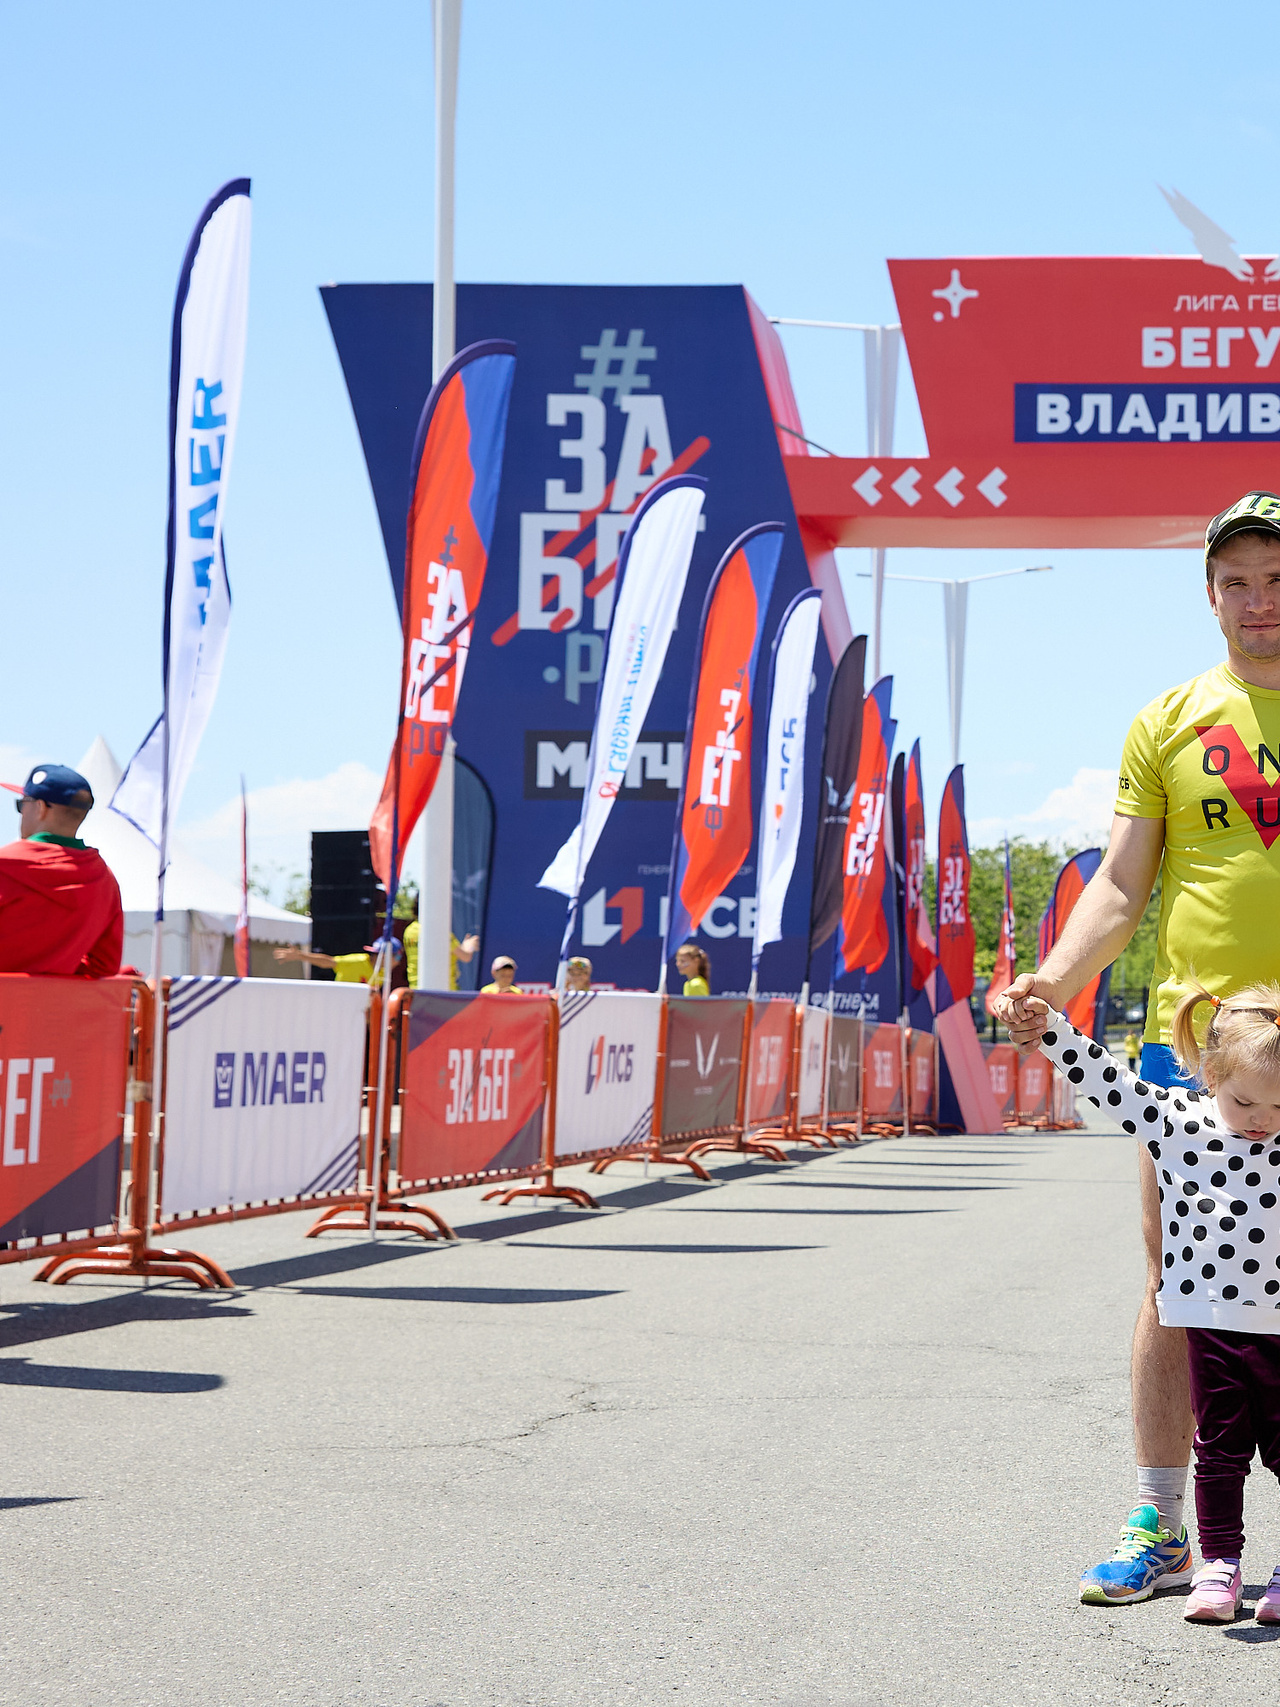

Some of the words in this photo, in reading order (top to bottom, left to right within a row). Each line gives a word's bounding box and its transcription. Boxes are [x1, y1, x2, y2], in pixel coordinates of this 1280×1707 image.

[1174, 294, 1240, 312] ЛИГА
[1118, 776, 1130, 790] СБ
[605, 1043, 634, 1084] ПСБ
[241, 1051, 326, 1107] MAER
